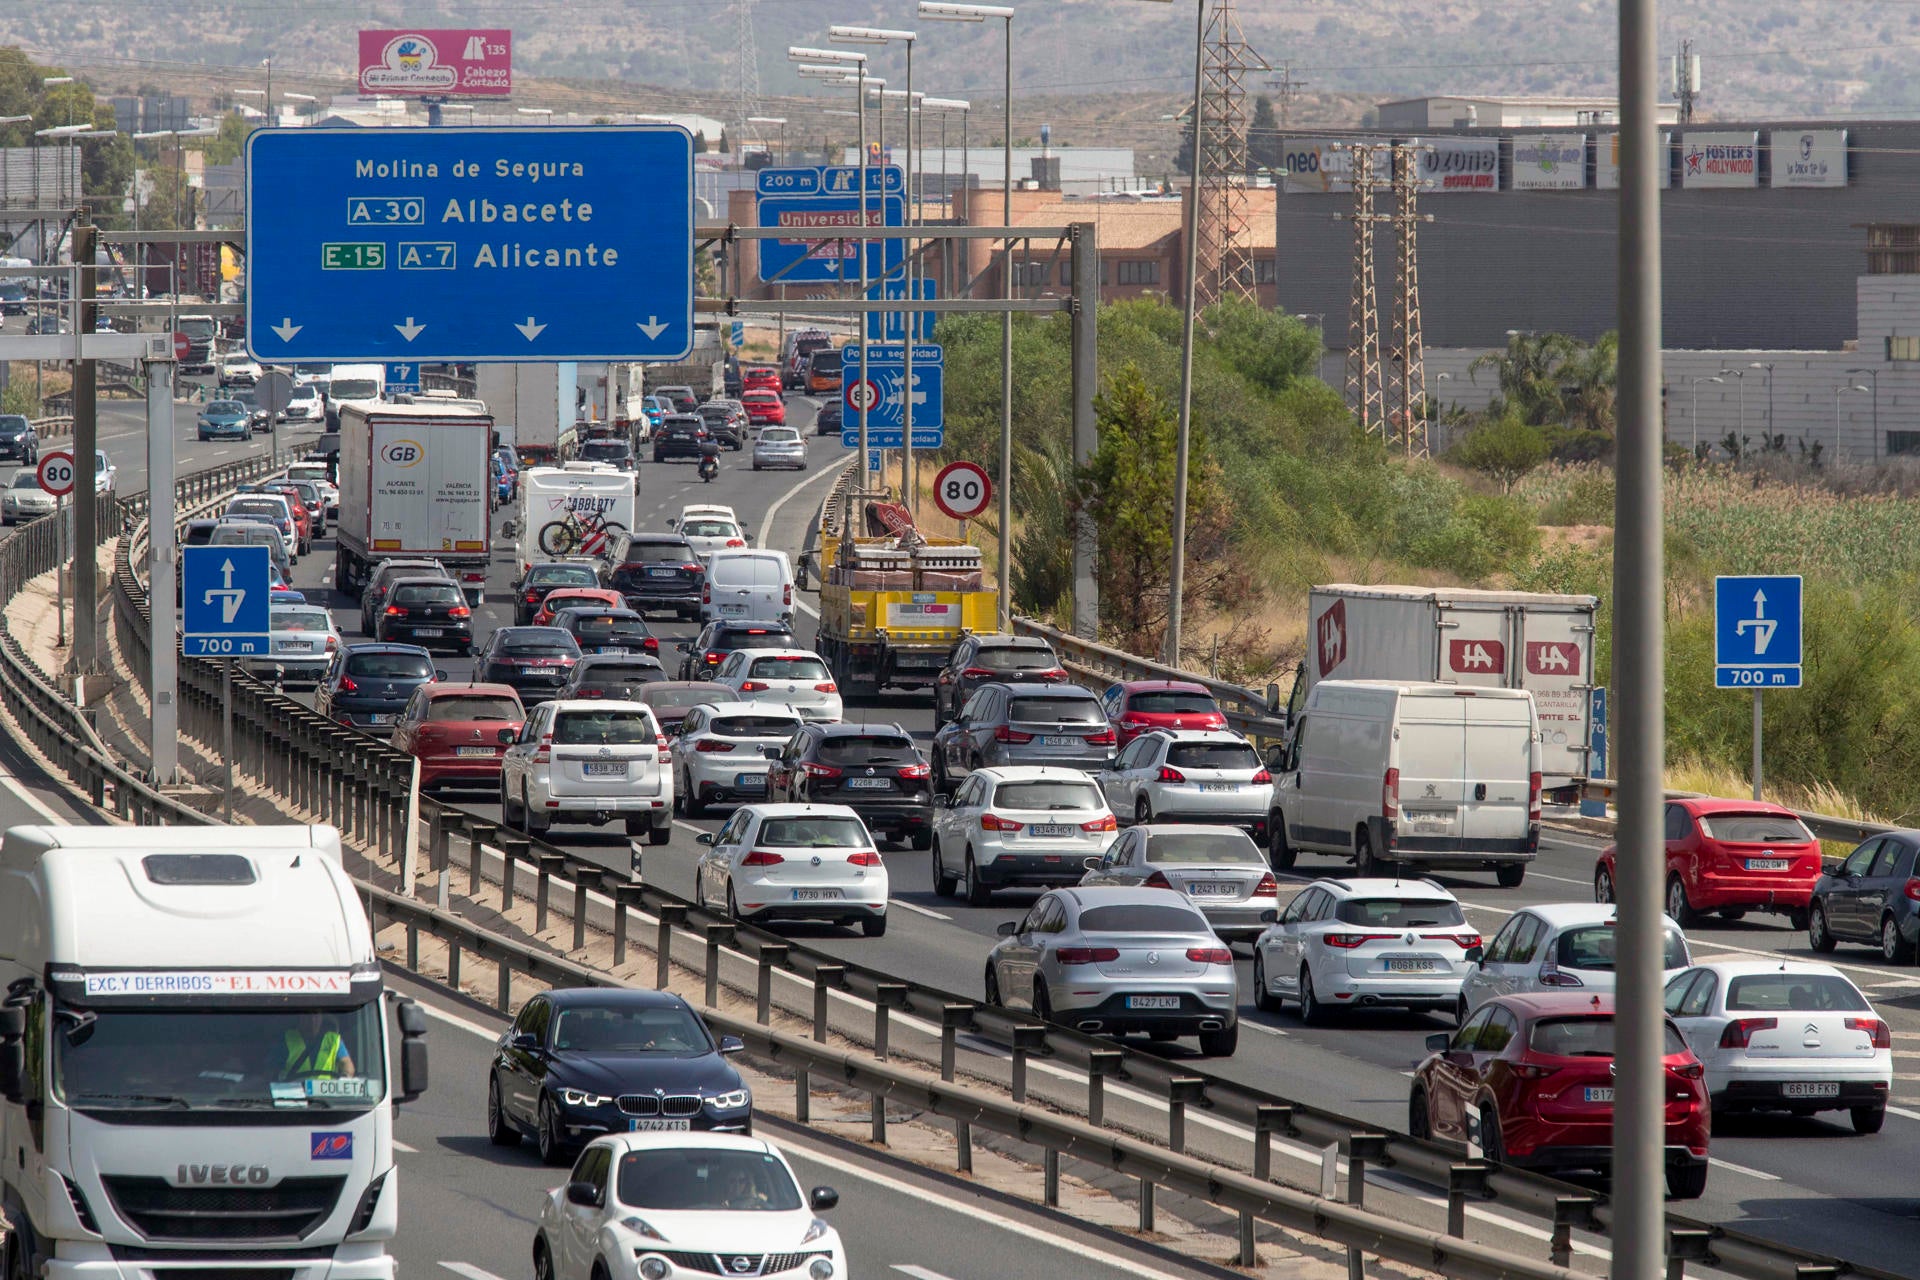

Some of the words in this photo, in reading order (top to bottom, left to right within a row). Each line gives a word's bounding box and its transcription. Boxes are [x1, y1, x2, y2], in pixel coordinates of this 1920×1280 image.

[486, 44, 506, 56] 135
[465, 66, 506, 77] Cabezo
[463, 77, 509, 87] Cortado
[356, 159, 439, 178] Molina
[452, 159, 481, 178] de
[495, 159, 584, 183] Segura
[1707, 159, 1754, 174] HOLLYWOOD
[765, 175, 794, 187] 200
[800, 178, 812, 186] m
[352, 201, 421, 222] A-30
[441, 199, 593, 223] Albacete
[325, 246, 382, 266] E-15
[403, 246, 453, 266] A-7
[474, 243, 618, 268] Alicante
[870, 350, 882, 358] su
[888, 349, 938, 359] segridad
[389, 447, 416, 461] GB
[47, 466, 71, 481] 80
[946, 481, 979, 500] 80
[198, 639, 233, 653] 700
[241, 642, 255, 653] m
[1731, 671, 1764, 684] 700
[1772, 674, 1785, 684] m
[1034, 825, 1055, 835] 9346
[1057, 825, 1072, 835] HCY
[798, 890, 819, 900] 9730
[822, 890, 838, 900] HXV
[1197, 885, 1217, 894] 2421
[1390, 960, 1412, 970] 6068
[1416, 960, 1434, 970] KSS
[135, 975, 212, 991] DERRIBOS
[1130, 997, 1156, 1009] 8427
[1159, 997, 1179, 1009] LKP
[320, 1081, 366, 1096] COLETA
[1789, 1084, 1816, 1095] 6618
[1817, 1084, 1838, 1095] FKR
[635, 1119, 664, 1131] 4742
[666, 1119, 689, 1131] KTS
[177, 1163, 270, 1185] IVECO
